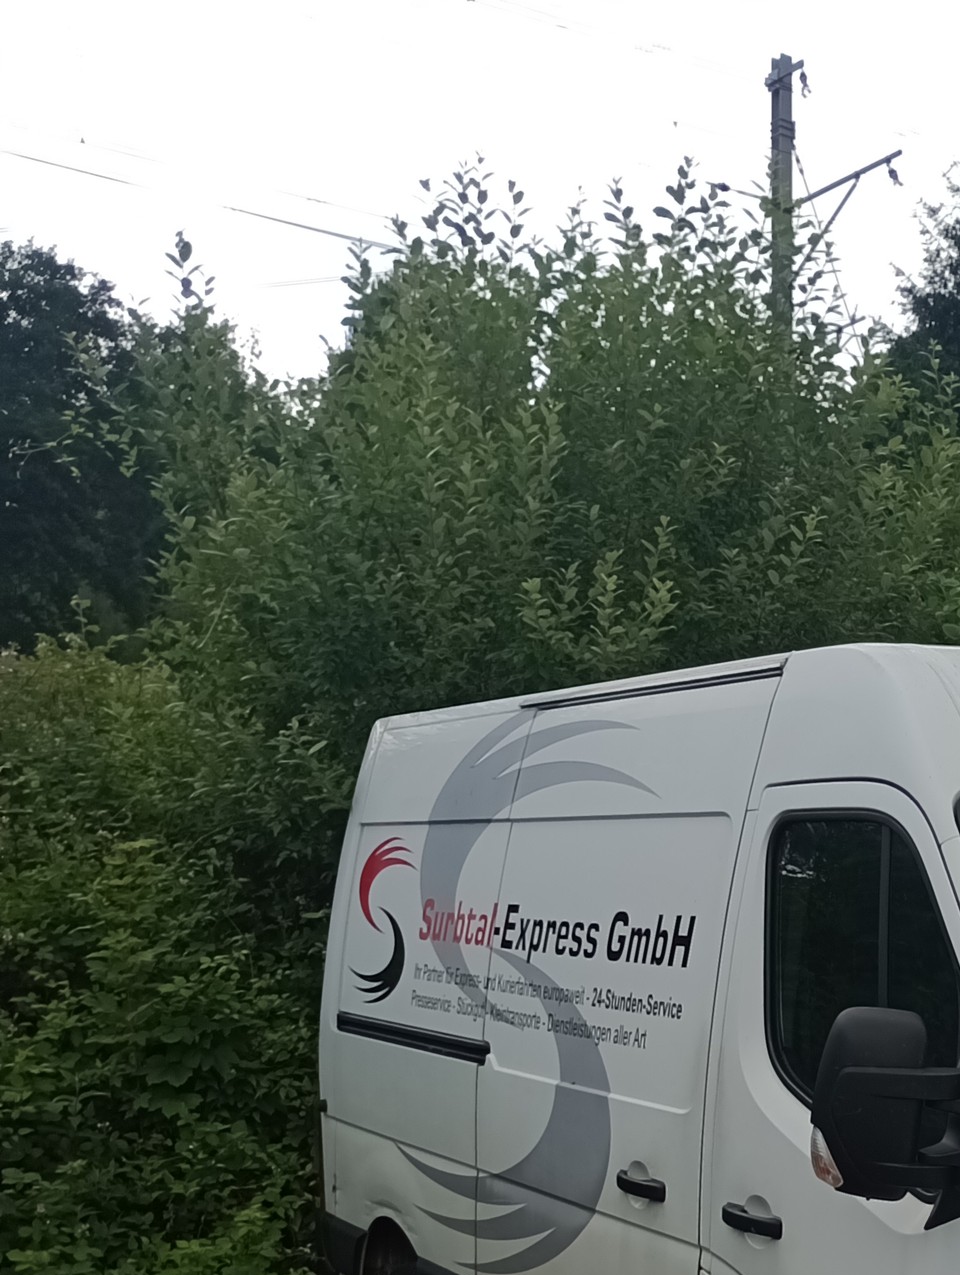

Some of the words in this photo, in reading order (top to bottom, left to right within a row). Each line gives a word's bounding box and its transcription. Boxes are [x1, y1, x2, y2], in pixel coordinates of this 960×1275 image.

[418, 897, 600, 964] Surbtal-Express
[606, 911, 697, 968] GmbH
[591, 987, 683, 1020] 24-Stunden-Service
[547, 1013, 611, 1046] Dienstleistungen
[613, 1025, 633, 1045] aller
[632, 1027, 648, 1049] Art
